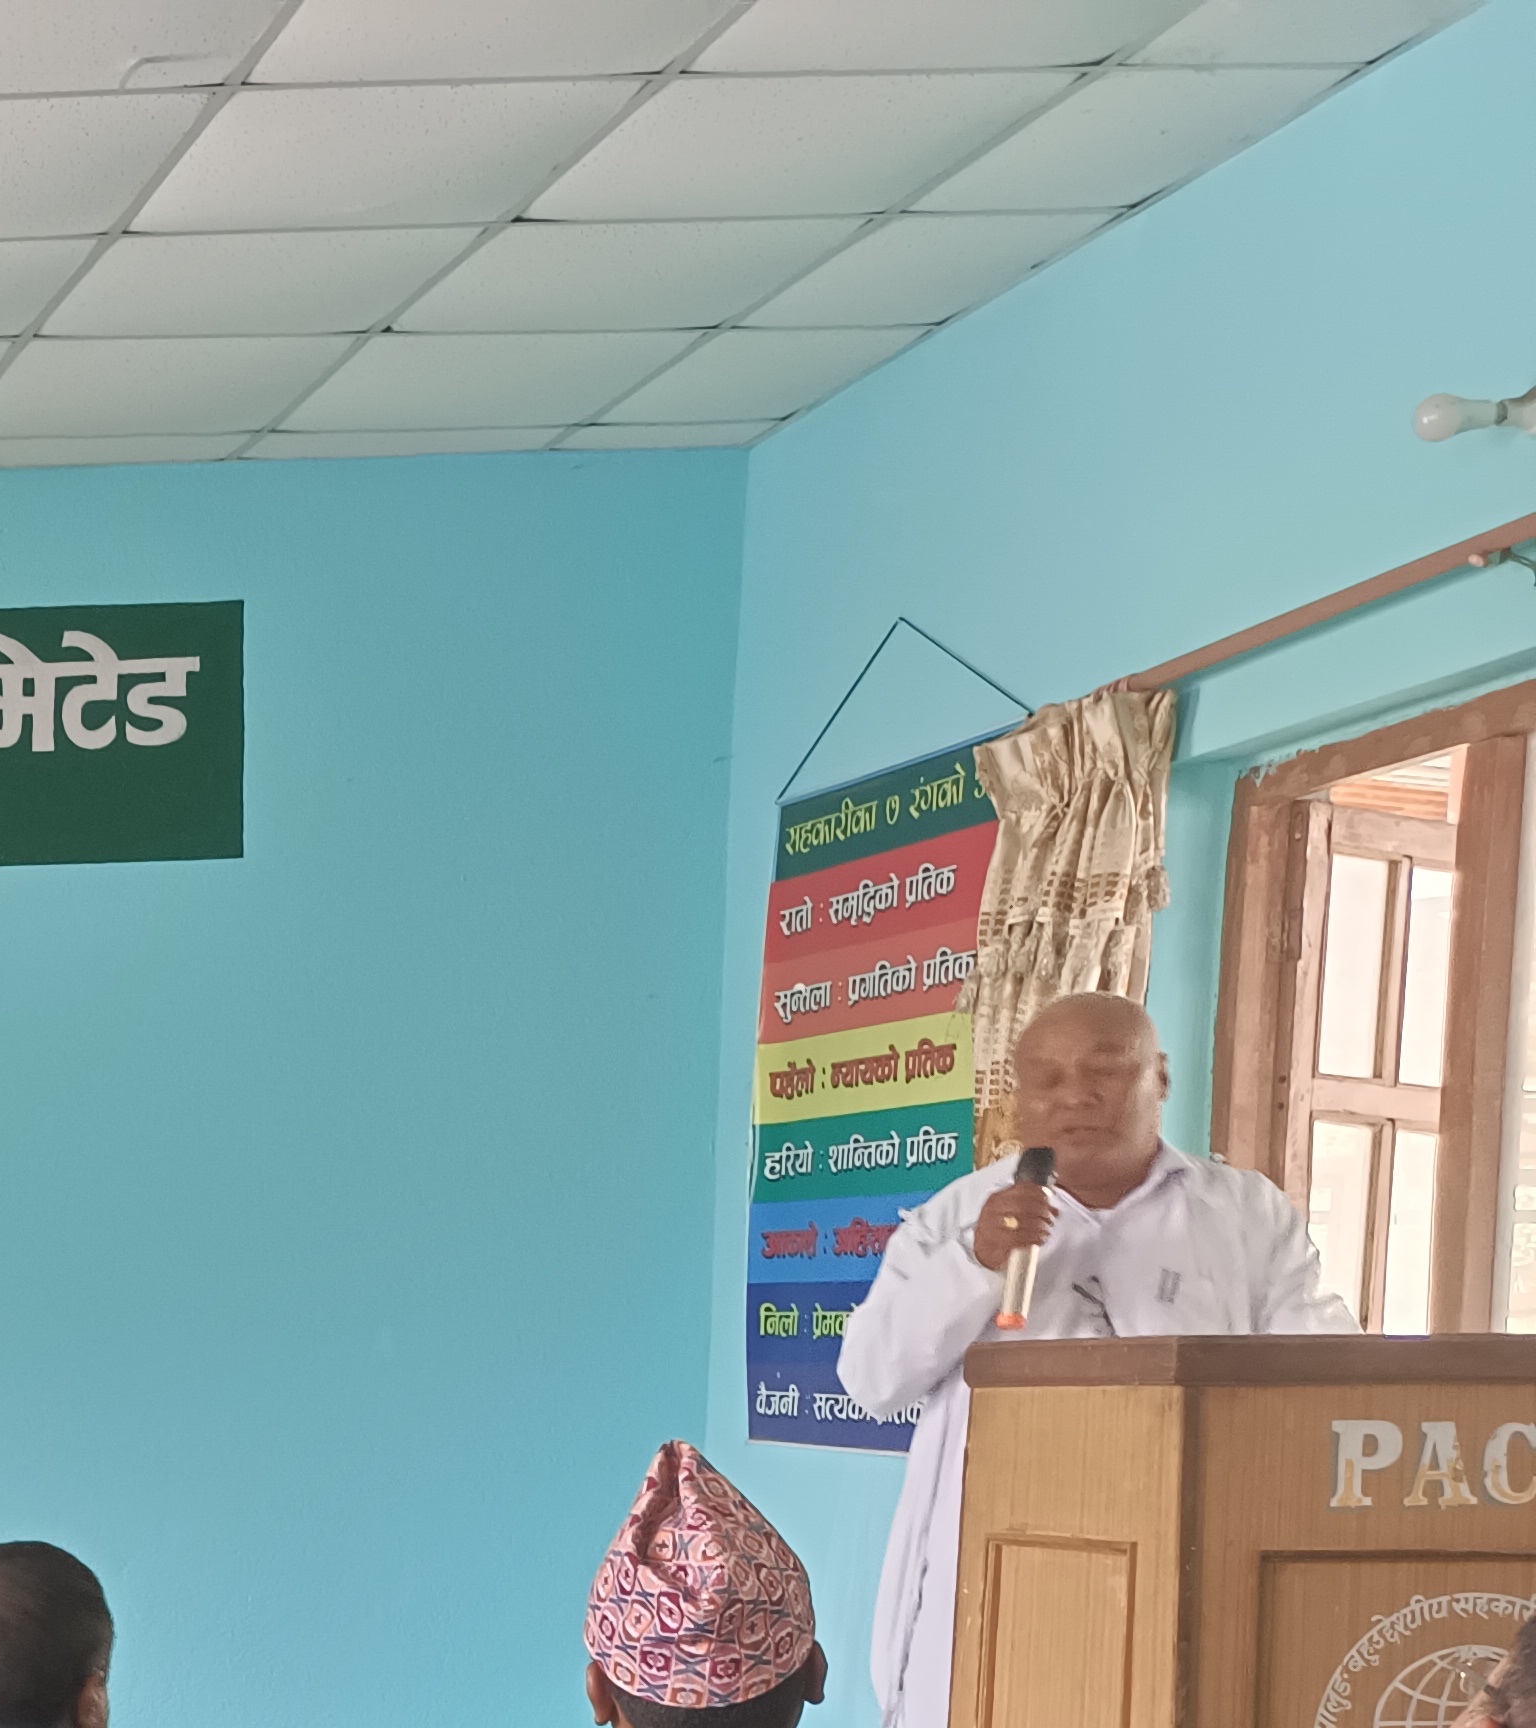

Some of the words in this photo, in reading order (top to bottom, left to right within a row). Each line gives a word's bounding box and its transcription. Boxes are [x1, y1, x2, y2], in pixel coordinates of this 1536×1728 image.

[785, 797, 879, 856] सहकारीका
[779, 896, 814, 936] रातो
[904, 862, 958, 909] प्रतिक
[847, 954, 918, 1006] प्रगतिको
[922, 946, 977, 992] प्रतिक
[904, 1037, 957, 1084] प्रतिक
[763, 1140, 814, 1181] हरियो
[828, 1130, 901, 1173] शान्तिको
[905, 1125, 959, 1168] प्रतिक
[759, 1302, 800, 1338] निलो
